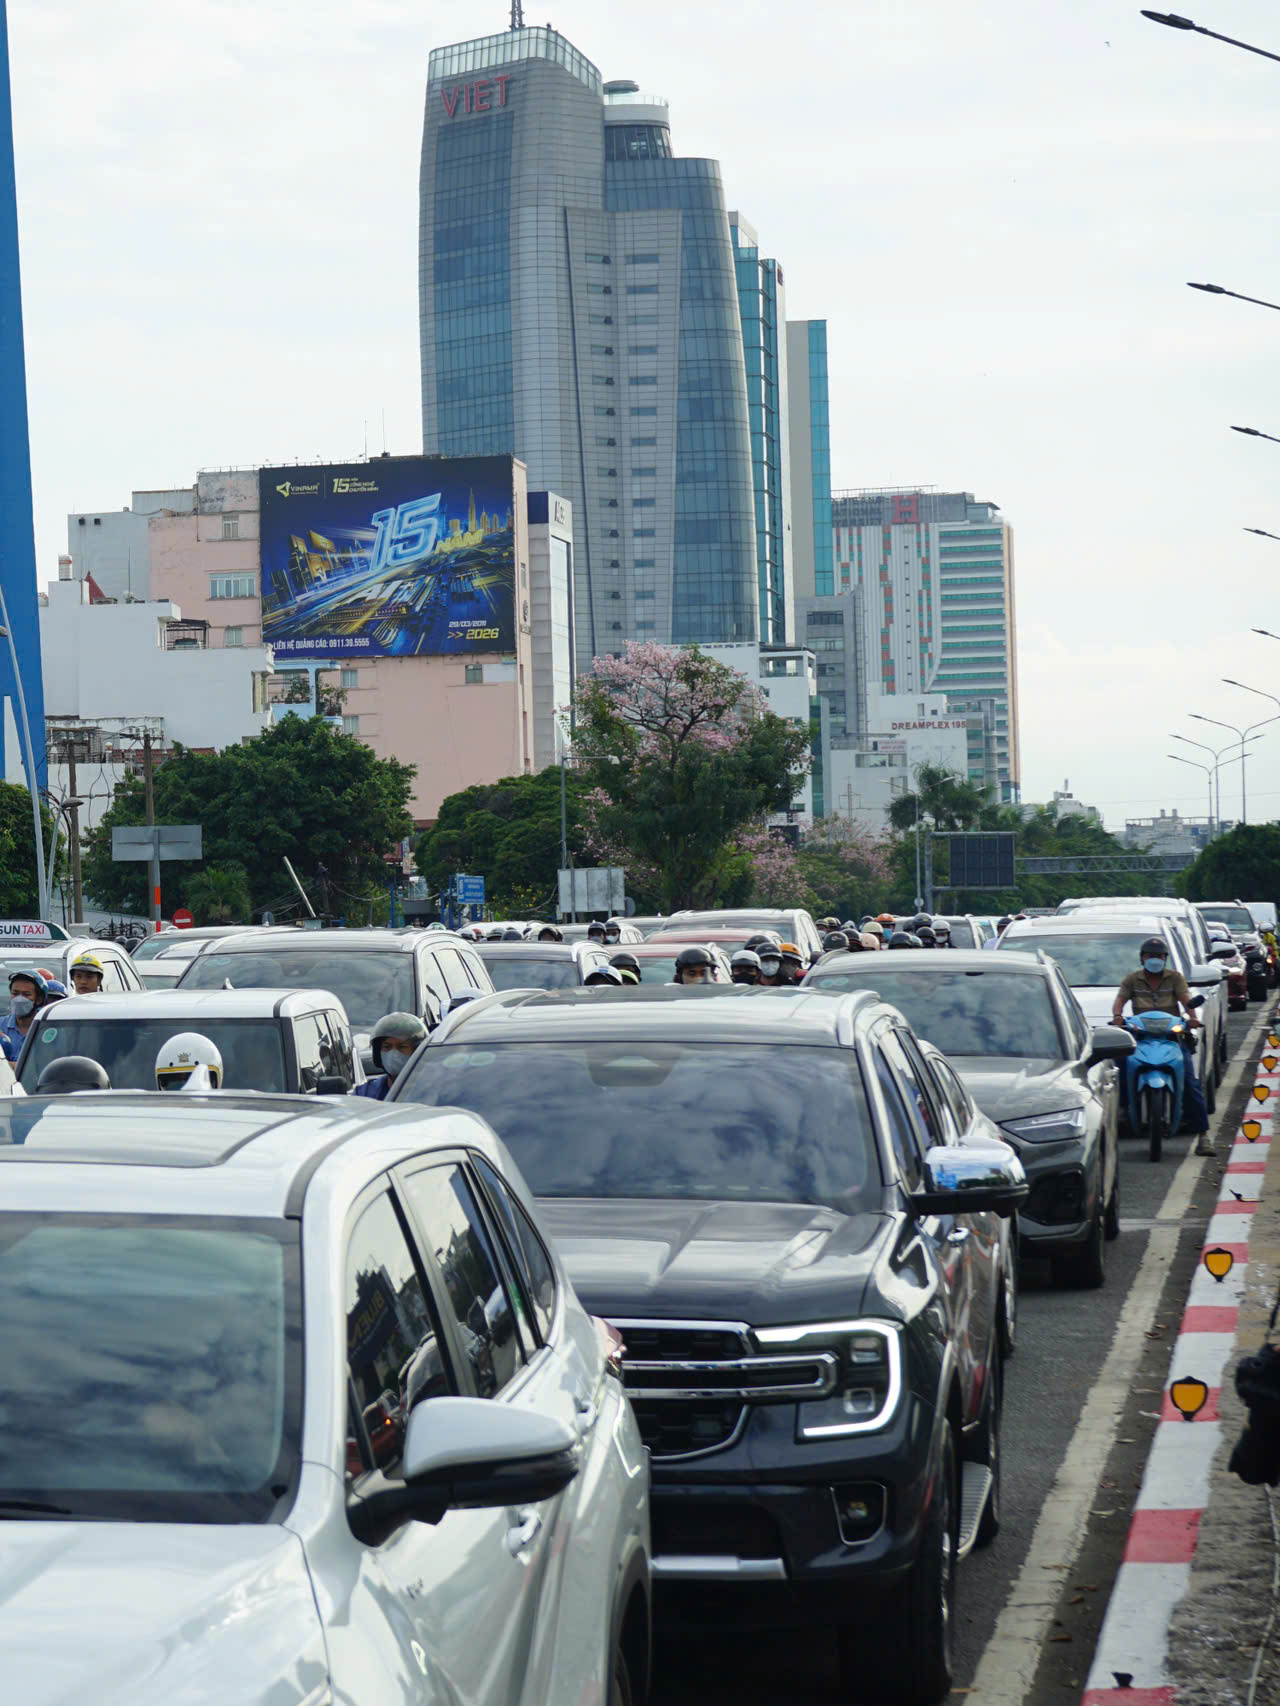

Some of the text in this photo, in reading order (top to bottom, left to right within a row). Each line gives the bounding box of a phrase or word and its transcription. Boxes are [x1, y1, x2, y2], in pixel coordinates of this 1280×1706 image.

[440, 74, 510, 118] VIET
[333, 478, 350, 493] 15
[371, 493, 441, 573] 15
[465, 628, 499, 640] 2026
[273, 637, 370, 650] LIÊN HỆ QUẢNG CÁO: 0911.39.5555
[892, 720, 967, 730] DREAMPLEX 195
[22, 925, 45, 935] TAXI
